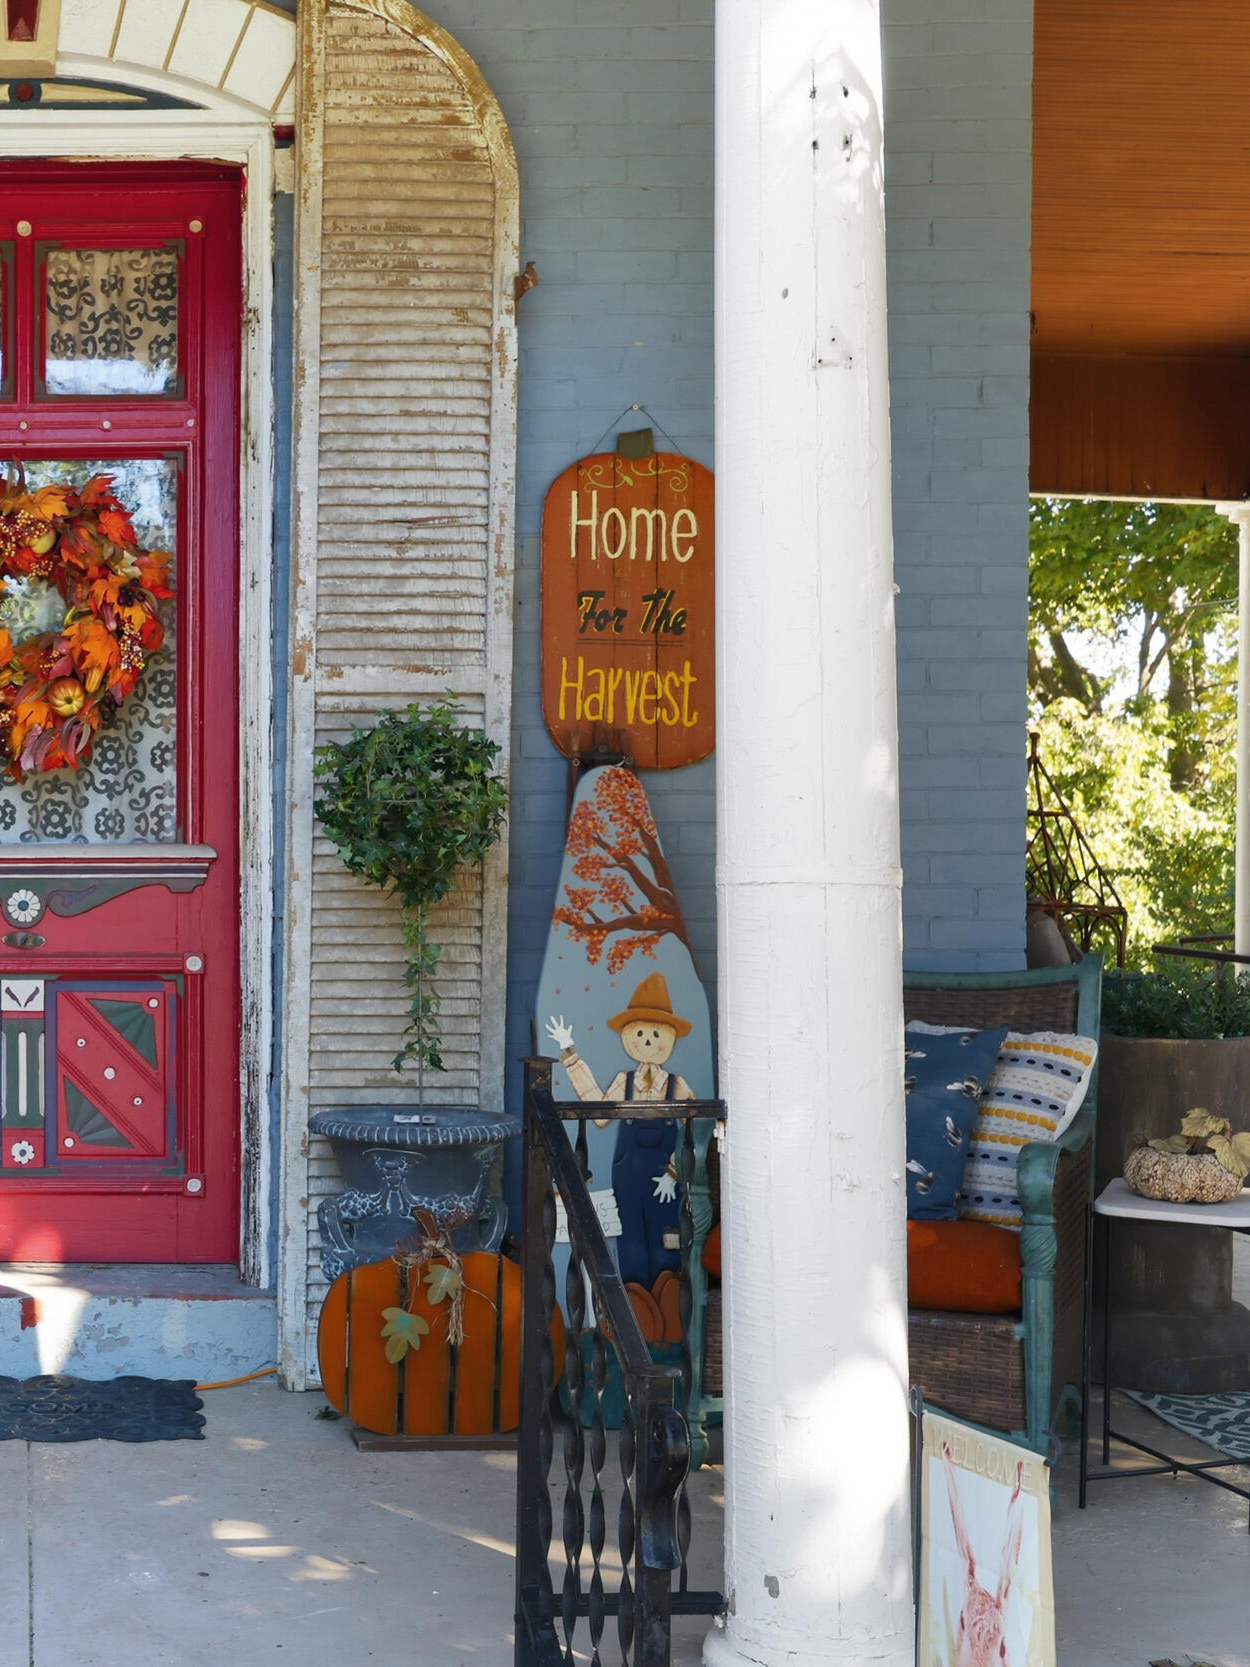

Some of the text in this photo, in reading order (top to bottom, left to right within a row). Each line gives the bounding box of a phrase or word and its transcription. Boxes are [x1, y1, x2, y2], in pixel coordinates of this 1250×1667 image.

[570, 490, 698, 562] Home
[576, 587, 687, 635] For The
[558, 656, 698, 727] Harvest
[933, 1425, 1035, 1491] WELCOME
